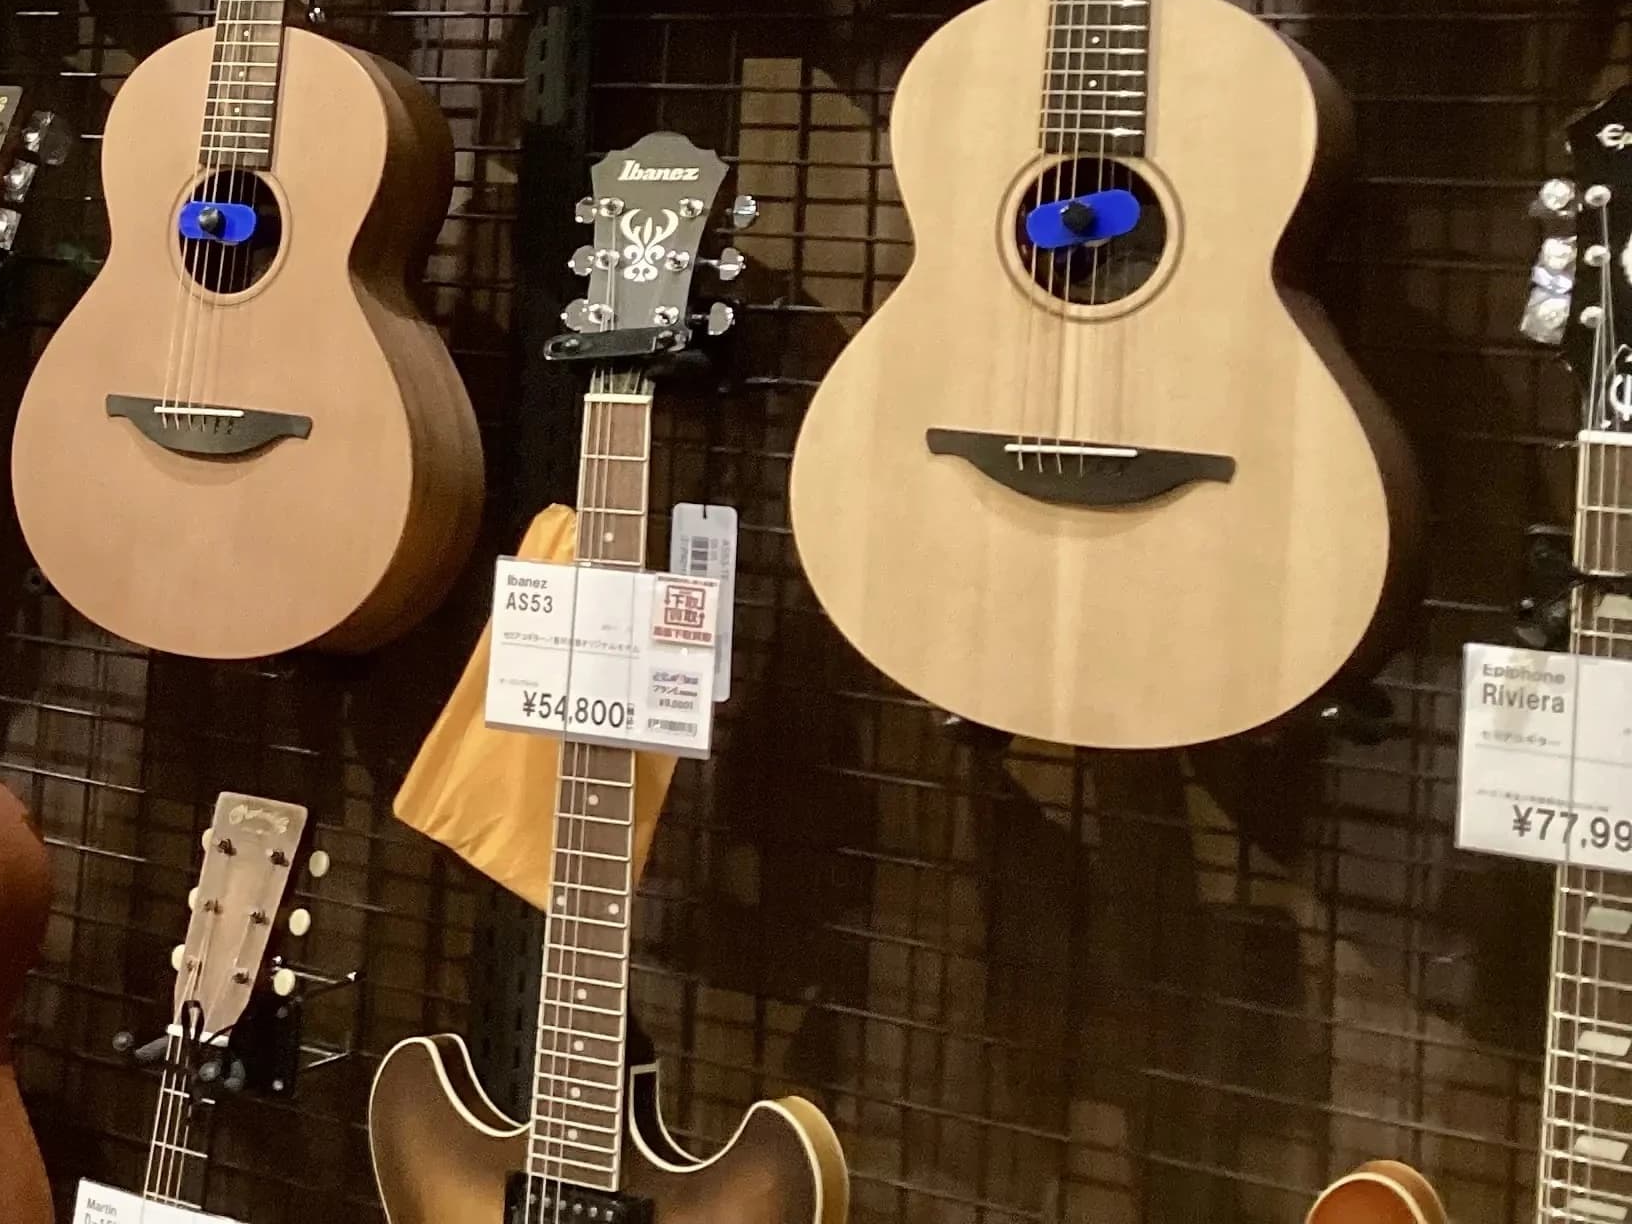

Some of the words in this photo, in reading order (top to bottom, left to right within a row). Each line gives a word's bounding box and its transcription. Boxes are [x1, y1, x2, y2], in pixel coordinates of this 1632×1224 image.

[618, 159, 701, 182] Ibanez
[507, 574, 548, 590] Ibanez
[505, 591, 554, 614] AS53
[1482, 663, 1566, 685] Epiphone
[523, 690, 625, 728] ¥54,800
[1481, 682, 1566, 714] Riviera
[86, 1197, 118, 1218] Martin
